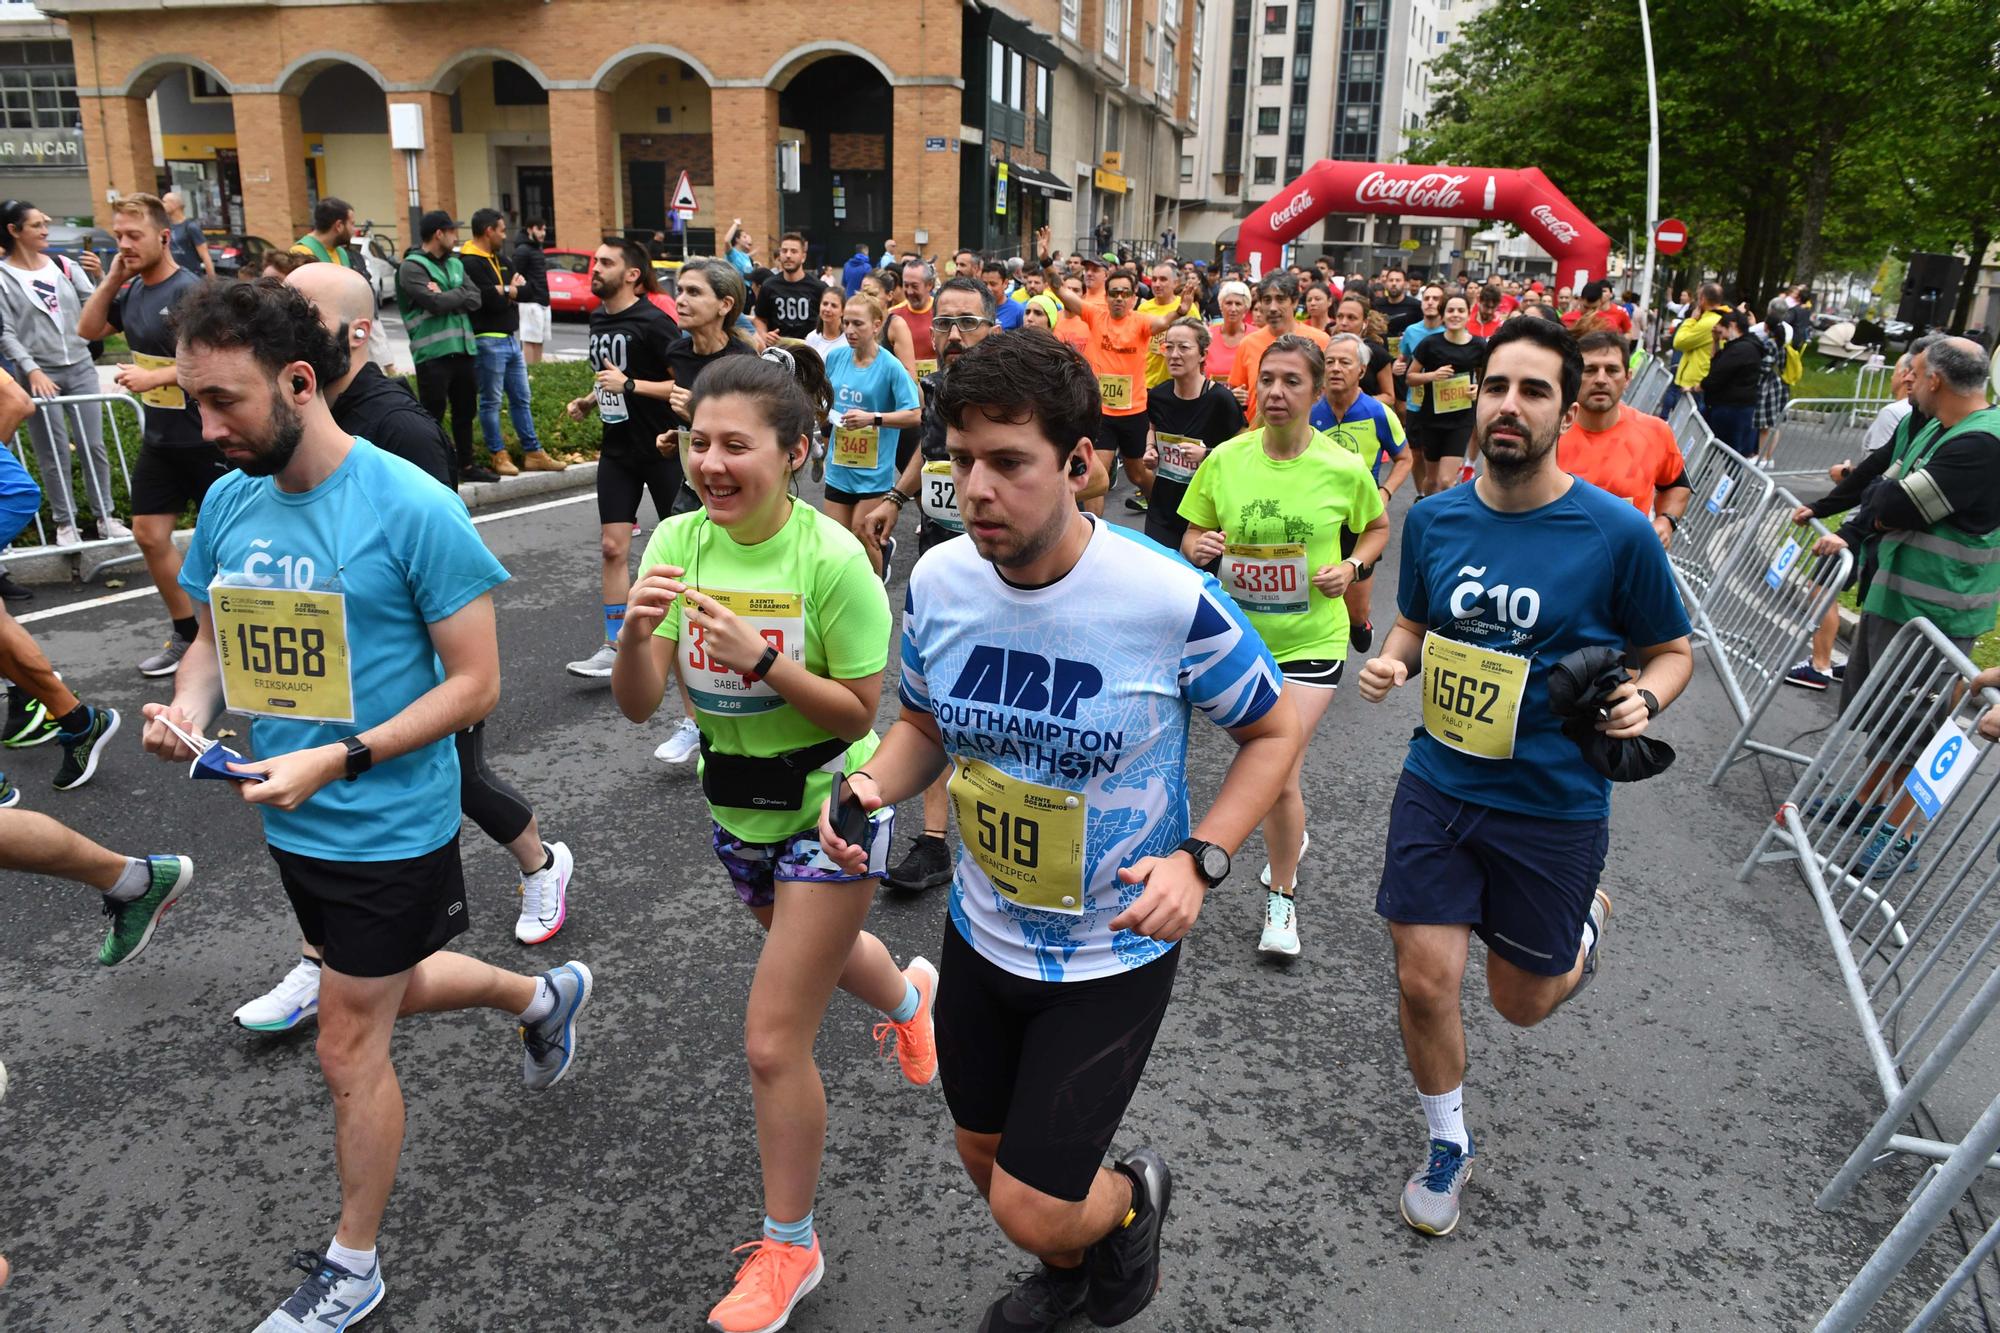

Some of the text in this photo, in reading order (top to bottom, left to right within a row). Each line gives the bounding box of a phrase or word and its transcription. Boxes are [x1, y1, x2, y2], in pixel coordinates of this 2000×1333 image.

[22, 141, 78, 156] ANCAR
[775, 297, 810, 321] 360
[1102, 383, 1123, 398] 204
[841, 436, 868, 454] 348
[931, 480, 957, 510] 32
[1231, 562, 1297, 592] 3330
[1470, 619, 1506, 633] Carreira
[219, 629, 229, 659] TANDA
[237, 623, 326, 678] 1568
[254, 678, 313, 692] ERIKSKAUCH
[948, 645, 1103, 721] ABP
[718, 700, 741, 709] 22.05
[1432, 666, 1501, 725] 1562
[932, 699, 1123, 752] SOUTHAMPTON
[1441, 714, 1472, 731] PABLO P
[1024, 798, 1038, 806] DOS
[1038, 801, 1068, 811] BARRIOS
[1029, 795, 1051, 803] XENTE
[977, 800, 1039, 869] 519
